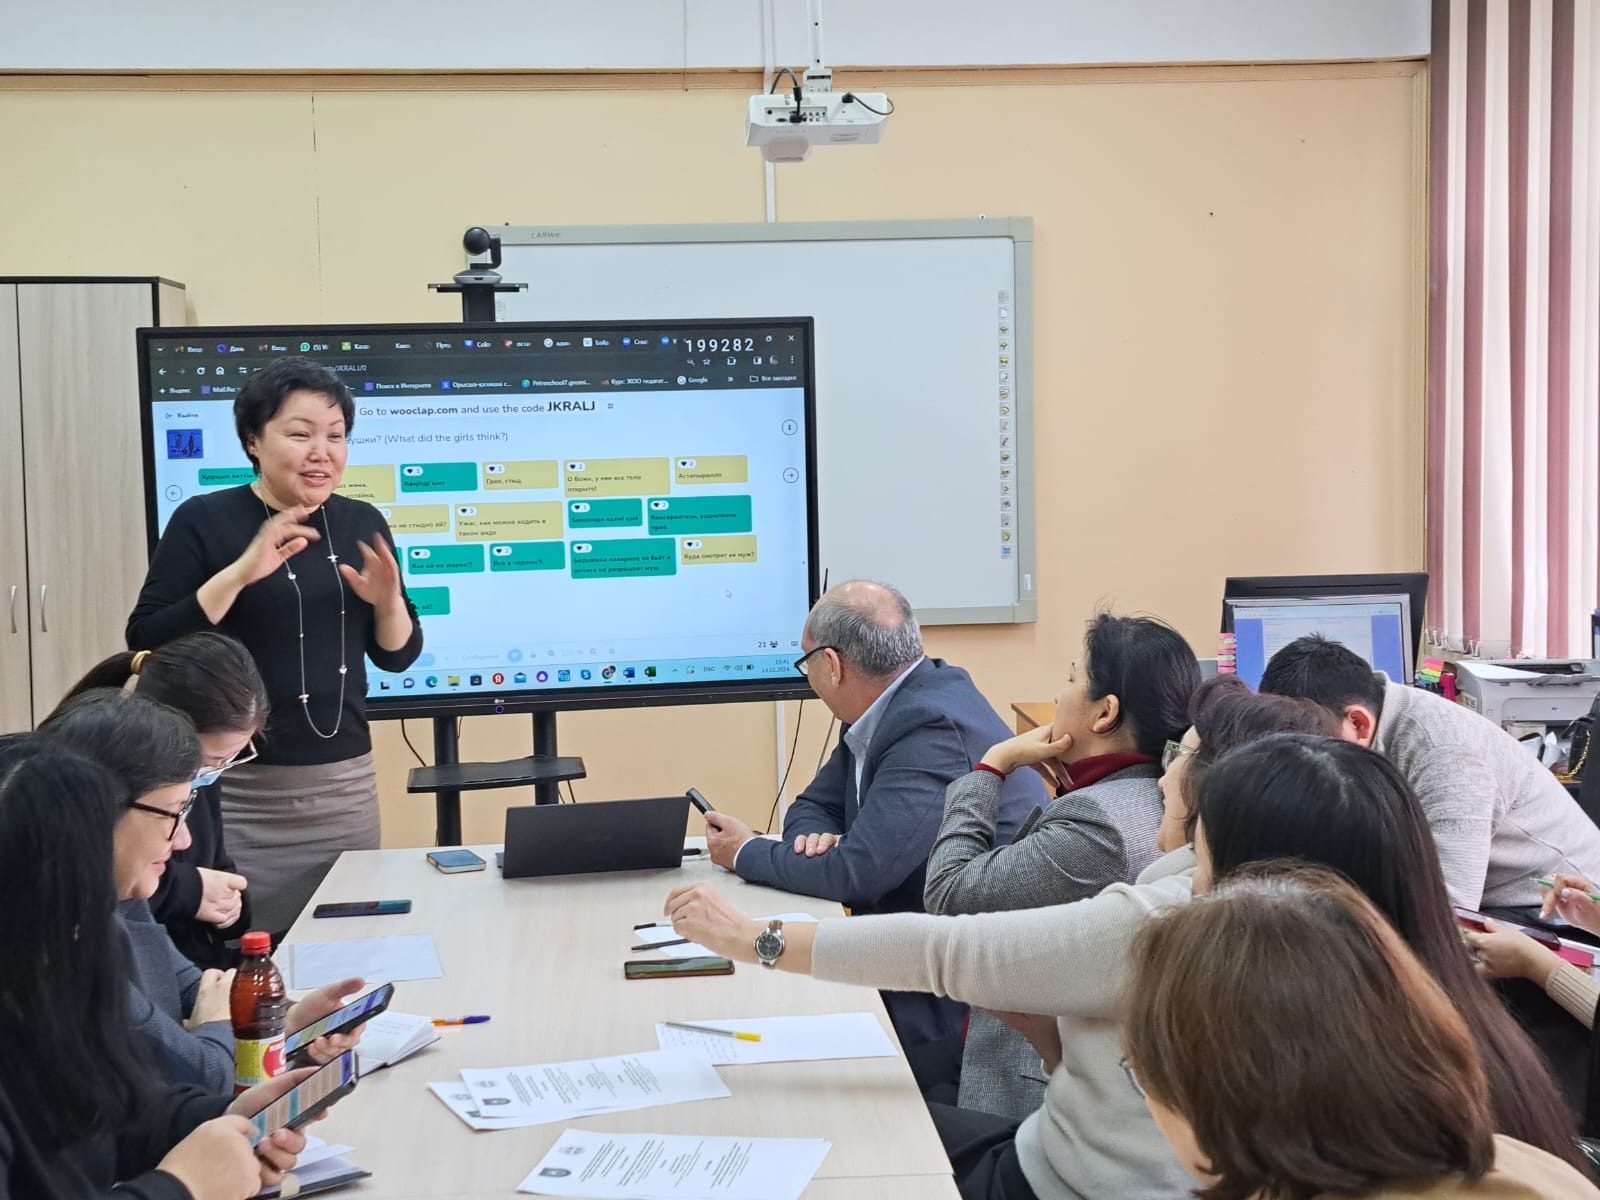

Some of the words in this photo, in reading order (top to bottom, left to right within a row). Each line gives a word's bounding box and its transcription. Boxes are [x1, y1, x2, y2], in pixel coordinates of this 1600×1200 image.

[685, 337, 754, 353] 199282
[688, 376, 708, 384] Google
[360, 407, 374, 416] Go
[376, 407, 387, 416] to
[389, 406, 458, 416] wooclap.com
[461, 405, 480, 414] and
[482, 405, 500, 414] use
[502, 404, 519, 413] the
[521, 403, 545, 412] code
[547, 400, 596, 412] JKRALJ
[384, 434, 416, 445] (What
[417, 433, 433, 443] did
[435, 433, 451, 442] the
[453, 432, 475, 444] girls
[477, 431, 509, 442] think?)
[757, 640, 767, 648] 21
[703, 665, 716, 673] ENG
